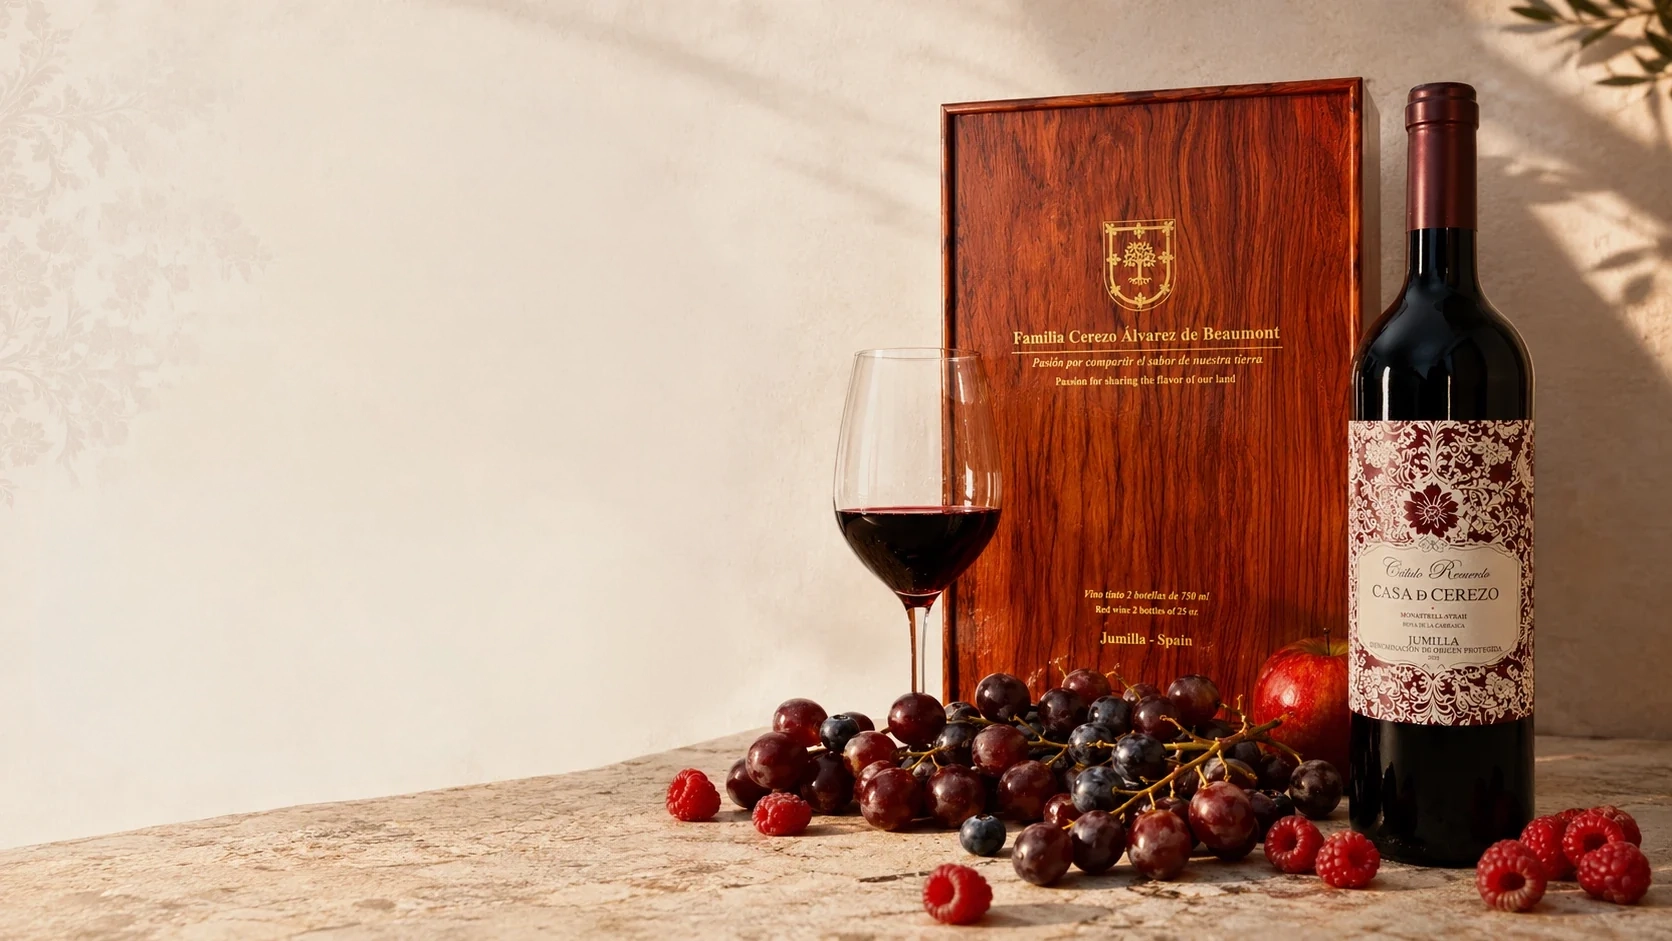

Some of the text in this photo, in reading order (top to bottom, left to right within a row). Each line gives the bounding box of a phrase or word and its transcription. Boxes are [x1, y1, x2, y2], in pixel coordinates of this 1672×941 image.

[1013, 325, 1280, 345] Familia Cerezo Álvarez de Beaumont
[1032, 354, 1264, 369] Pasión por compartir el sabor de nuestra tierra
[1089, 376, 1102, 386] for
[1105, 376, 1138, 387] sharing
[1140, 375, 1155, 385] the
[1157, 374, 1183, 385] flavor
[1186, 374, 1196, 385] of
[1197, 375, 1213, 384] our
[1215, 374, 1236, 384] land
[1084, 589, 1104, 599] Vino
[1105, 590, 1125, 599] tinto
[1126, 590, 1132, 600] 2
[1133, 590, 1166, 600] botellas
[1168, 590, 1179, 600] de
[1181, 591, 1197, 601] 750
[1372, 584, 1413, 601] CASA
[1430, 587, 1499, 602] CEREZO
[1095, 605, 1111, 614] Red
[1112, 605, 1131, 614] wine
[1132, 605, 1138, 614] 2
[1139, 606, 1166, 615] bottles
[1166, 606, 1177, 616] of
[1177, 606, 1188, 616] 25
[1100, 631, 1147, 645] Jumilla
[1157, 633, 1193, 649] Spain
[1408, 635, 1460, 646] JUMILLA
[1463, 645, 1503, 654] PROTEGIDA
